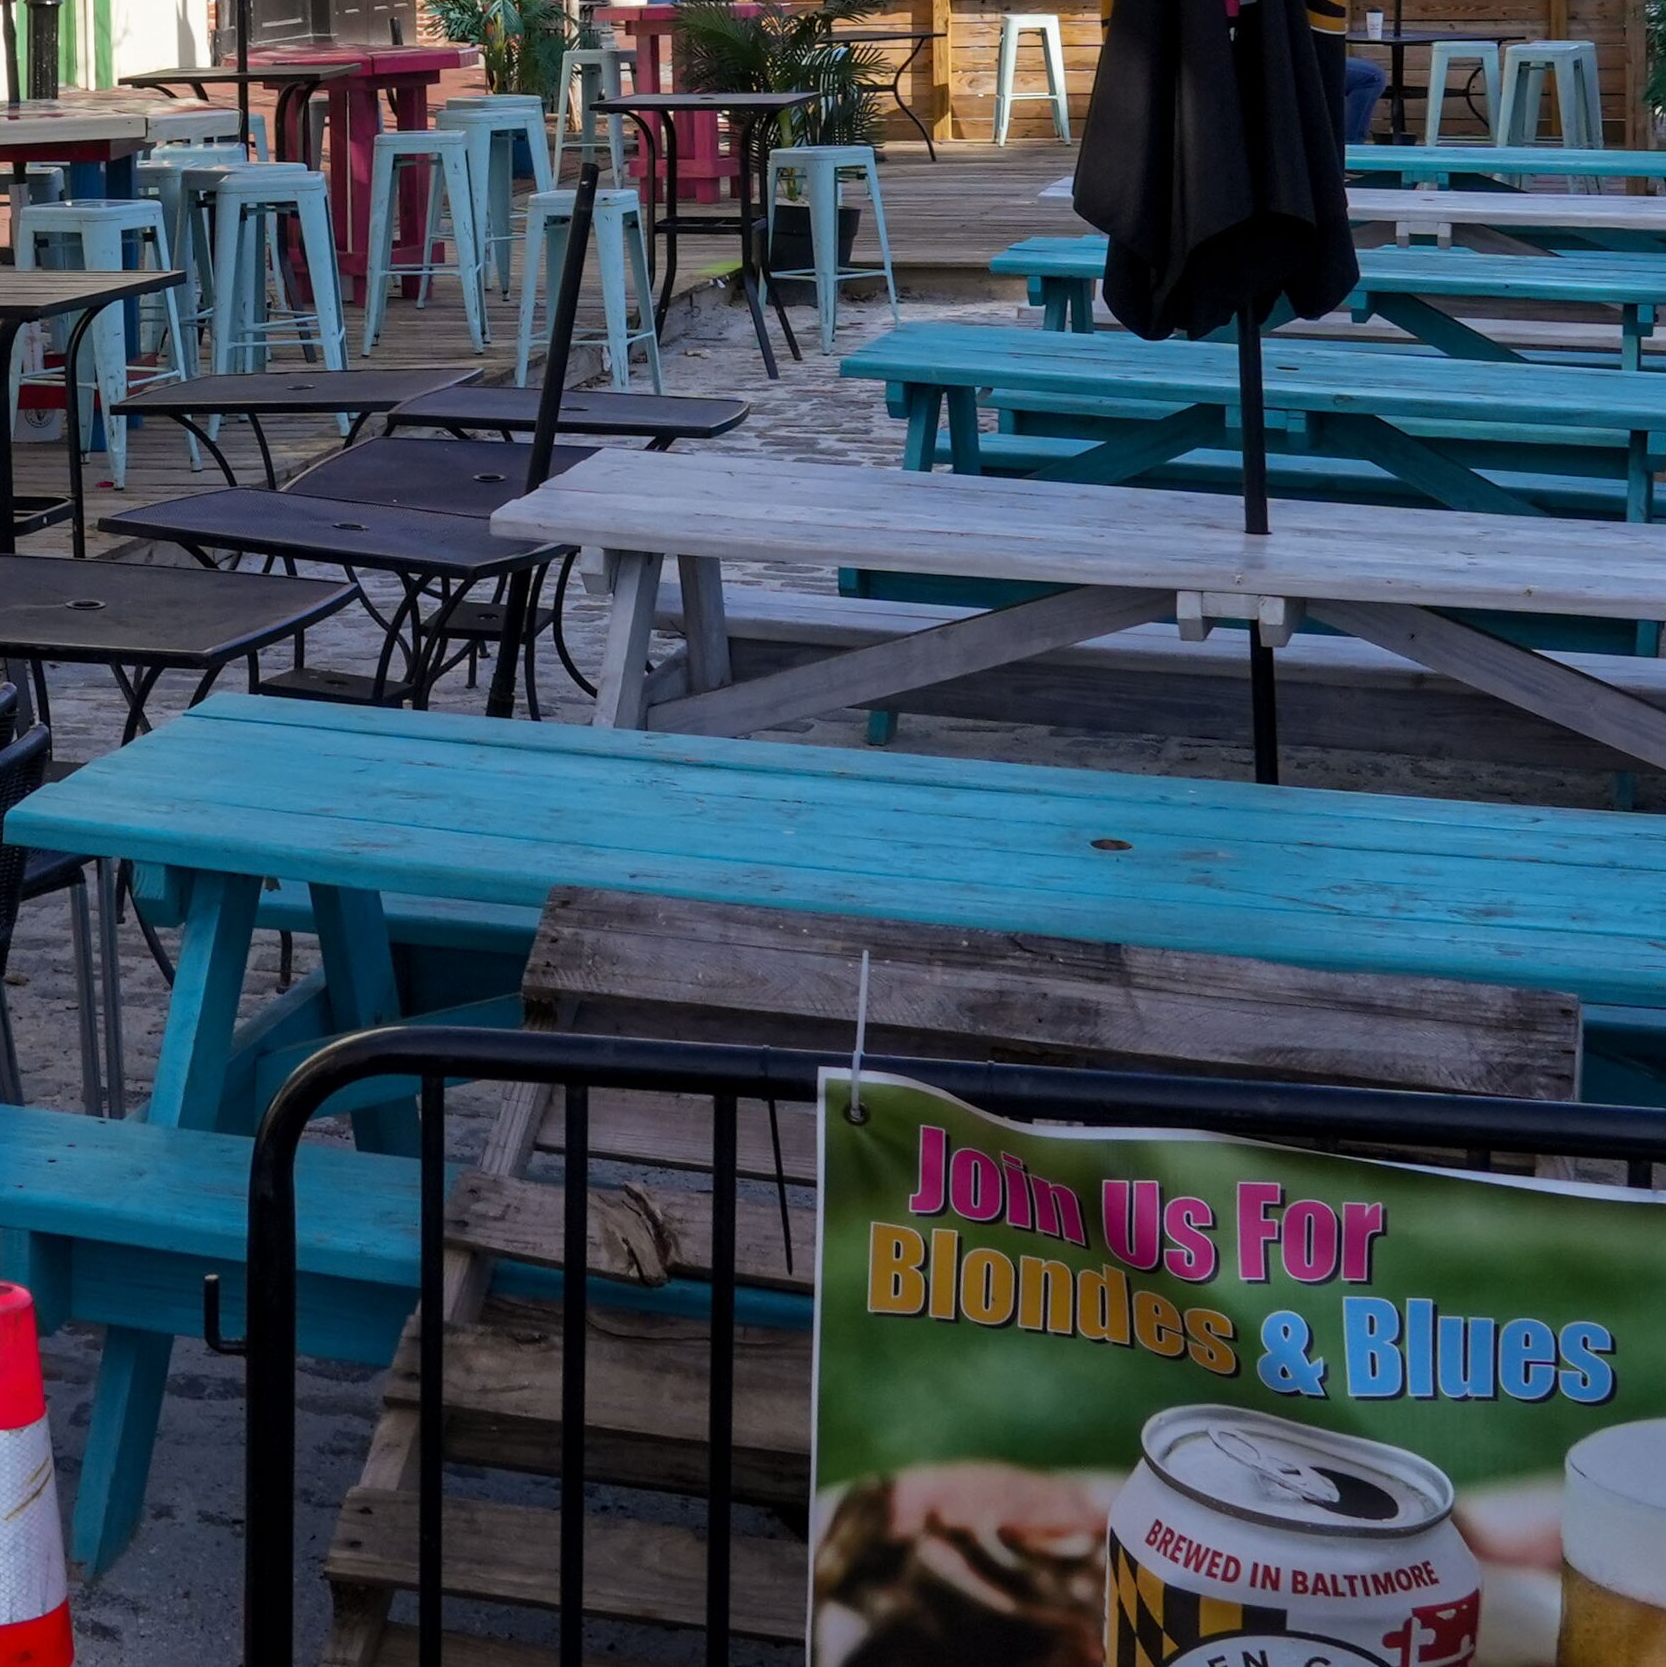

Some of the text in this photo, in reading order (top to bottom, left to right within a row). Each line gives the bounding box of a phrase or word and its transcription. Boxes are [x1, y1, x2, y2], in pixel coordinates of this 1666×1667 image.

[909, 1124, 1384, 1282] Join Us For
[867, 1221, 1616, 1404] Blondes & Blues
[1144, 1519, 1439, 1597] BREWED IN BALTIMORE
